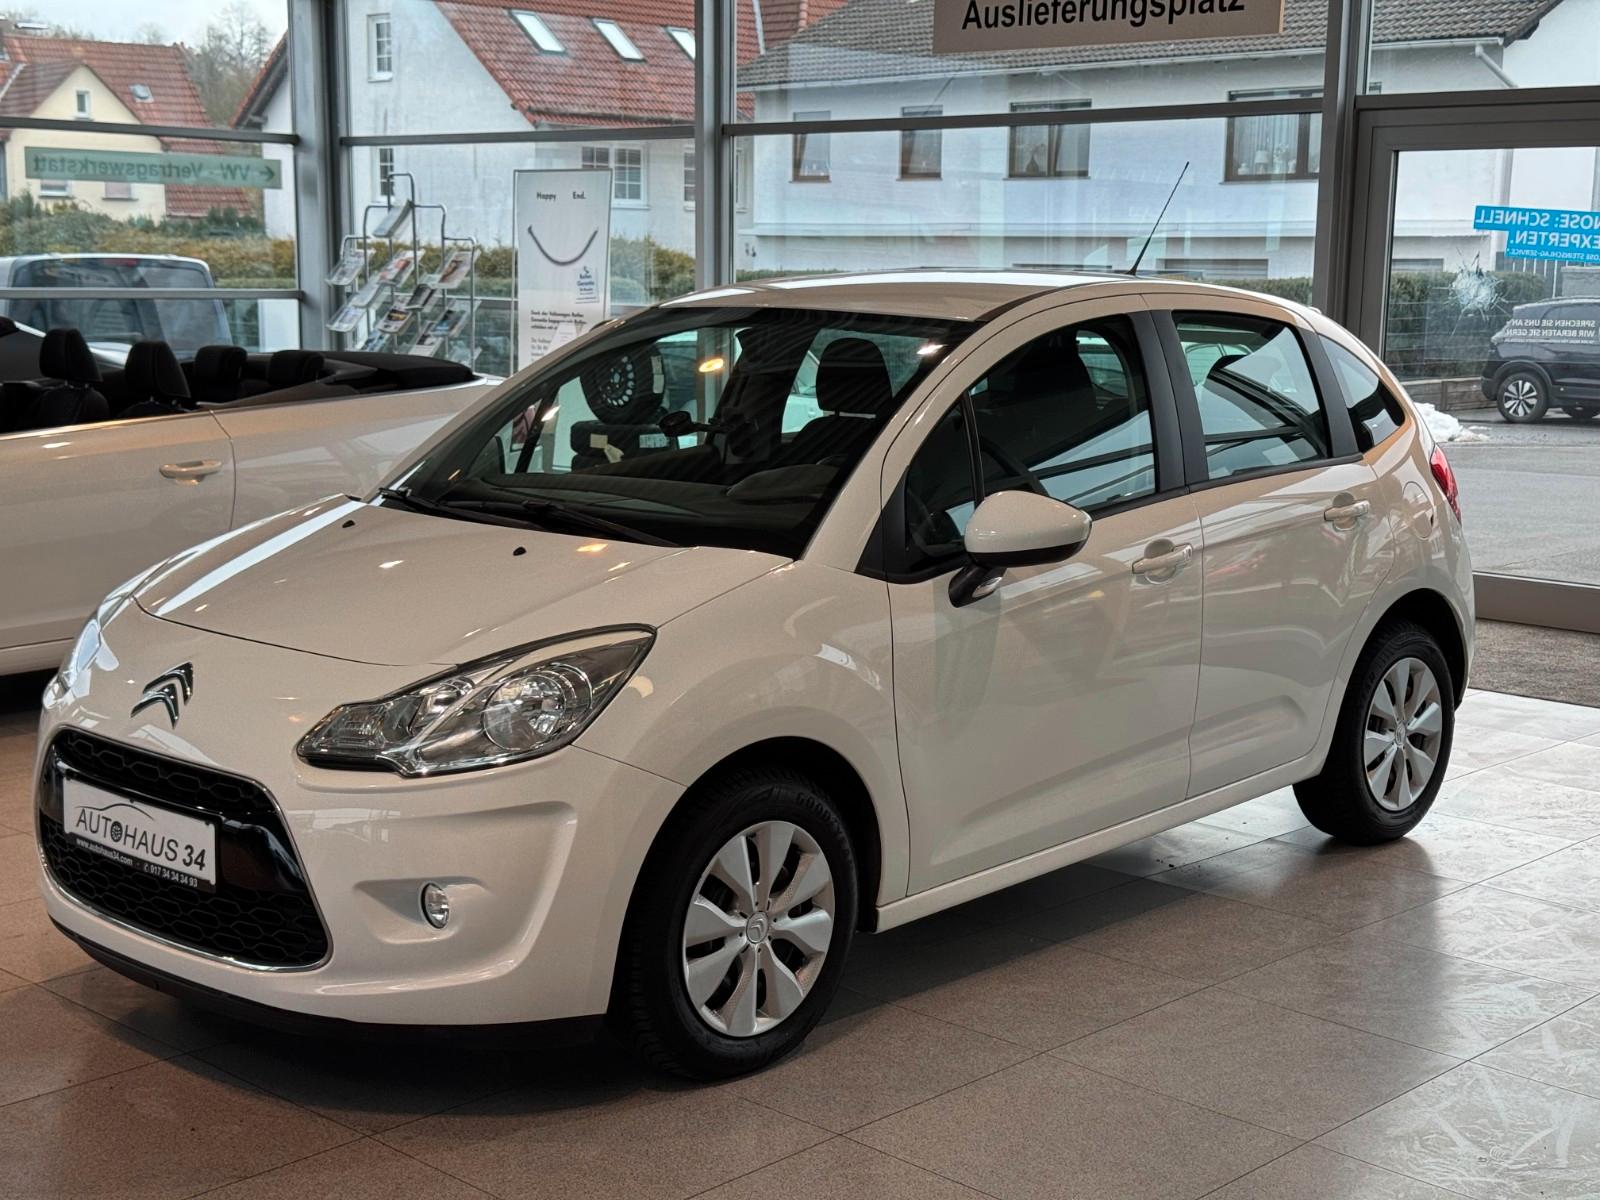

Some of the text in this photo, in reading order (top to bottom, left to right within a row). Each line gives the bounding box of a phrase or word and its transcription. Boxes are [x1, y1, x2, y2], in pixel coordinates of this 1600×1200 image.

[536, 191, 557, 202] Happy
[75, 807, 207, 871] AUTOHAUS 34
